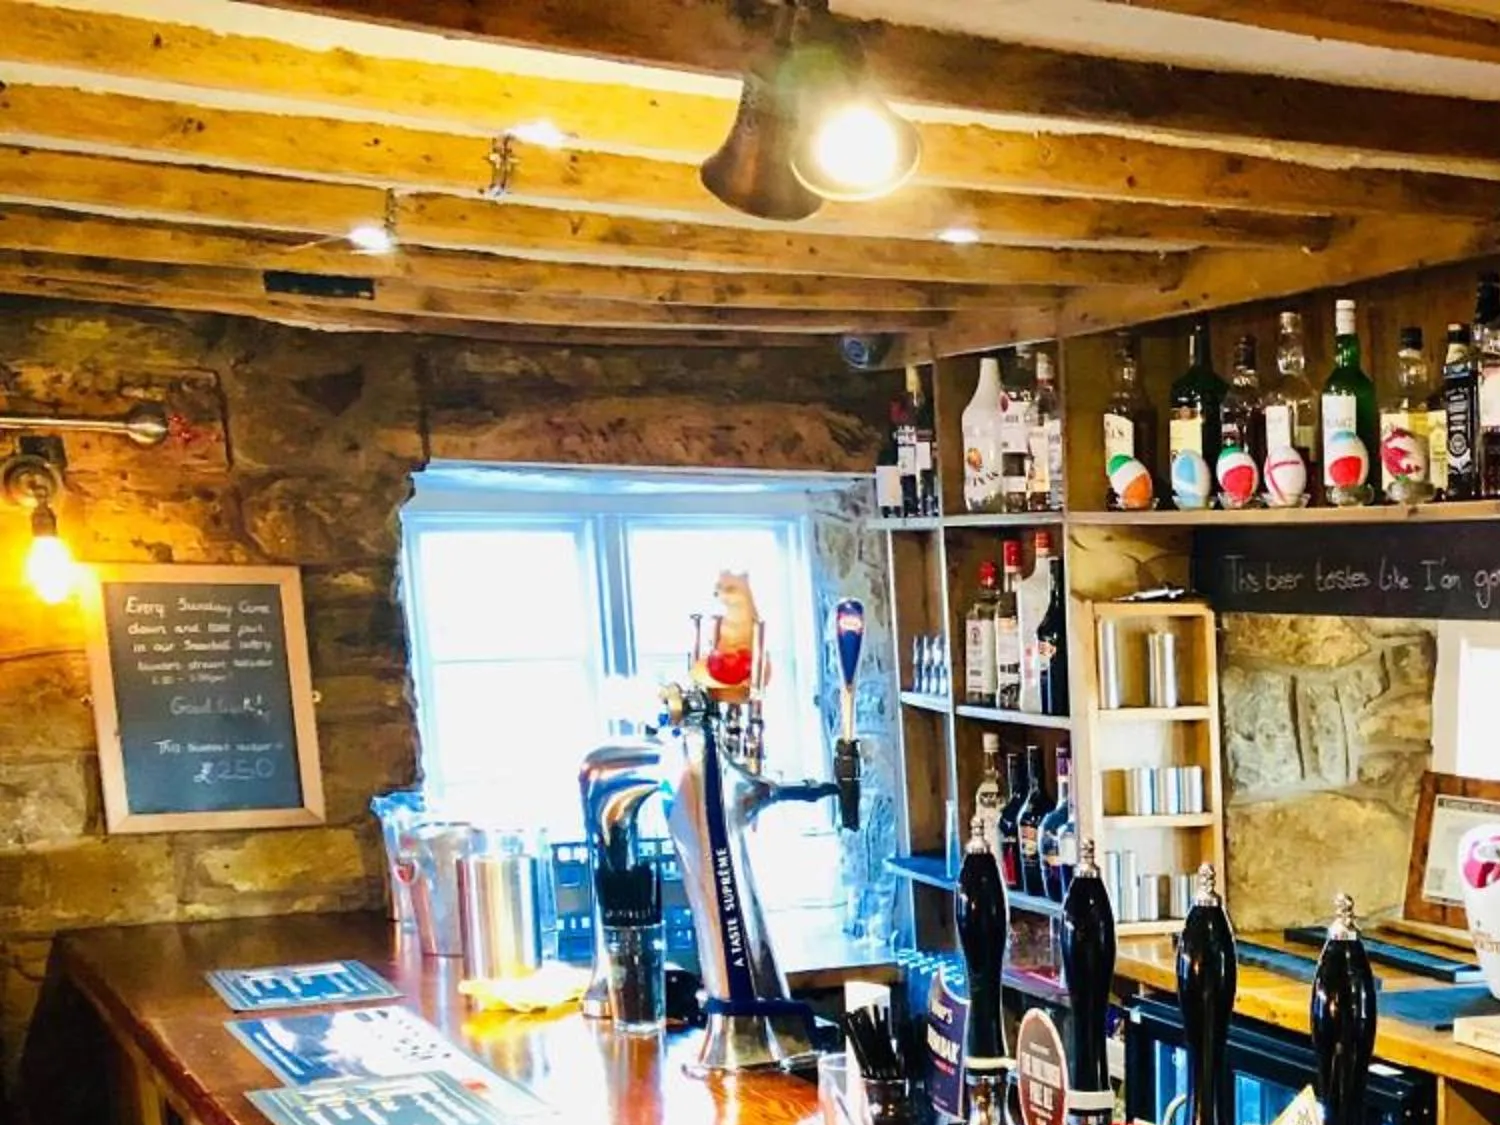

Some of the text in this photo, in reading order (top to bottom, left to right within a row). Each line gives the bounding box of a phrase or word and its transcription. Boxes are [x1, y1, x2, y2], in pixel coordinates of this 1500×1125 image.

[1223, 554, 1260, 593] This
[1266, 561, 1303, 591] beer
[1315, 557, 1371, 592] tastes
[1379, 555, 1410, 591] like
[125, 595, 167, 618] Every
[177, 597, 234, 618] Sunday
[727, 917, 742, 954] TASTE
[733, 957, 745, 967] A
